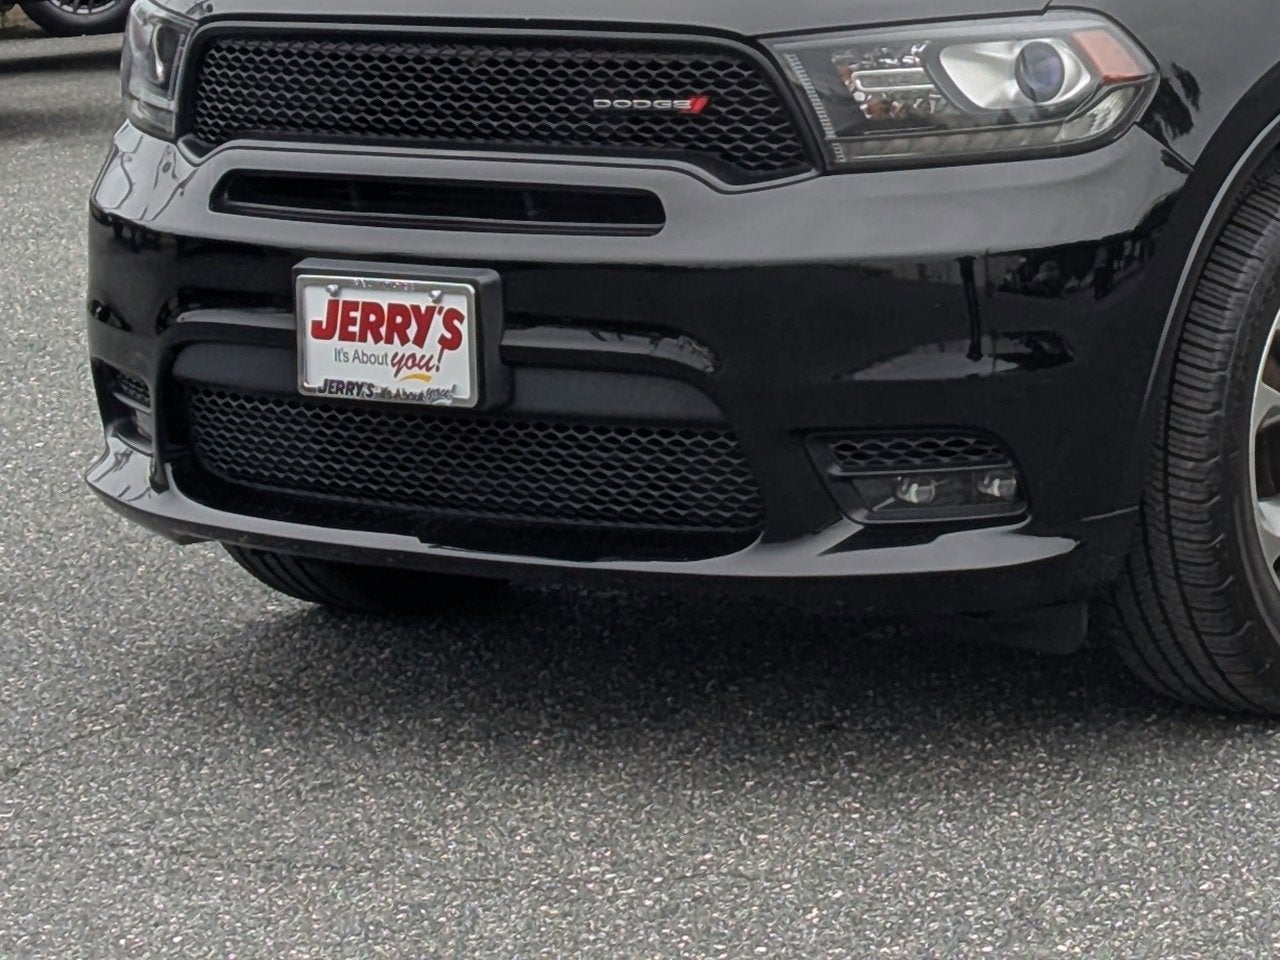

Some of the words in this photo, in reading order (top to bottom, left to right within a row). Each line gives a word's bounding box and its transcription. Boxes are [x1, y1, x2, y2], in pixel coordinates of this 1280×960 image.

[593, 99, 692, 109] DODGE
[311, 299, 465, 351] JERRY'S
[334, 348, 350, 363] It's
[352, 349, 389, 366] About
[390, 346, 446, 378] you!
[318, 378, 375, 398] JERRY'S
